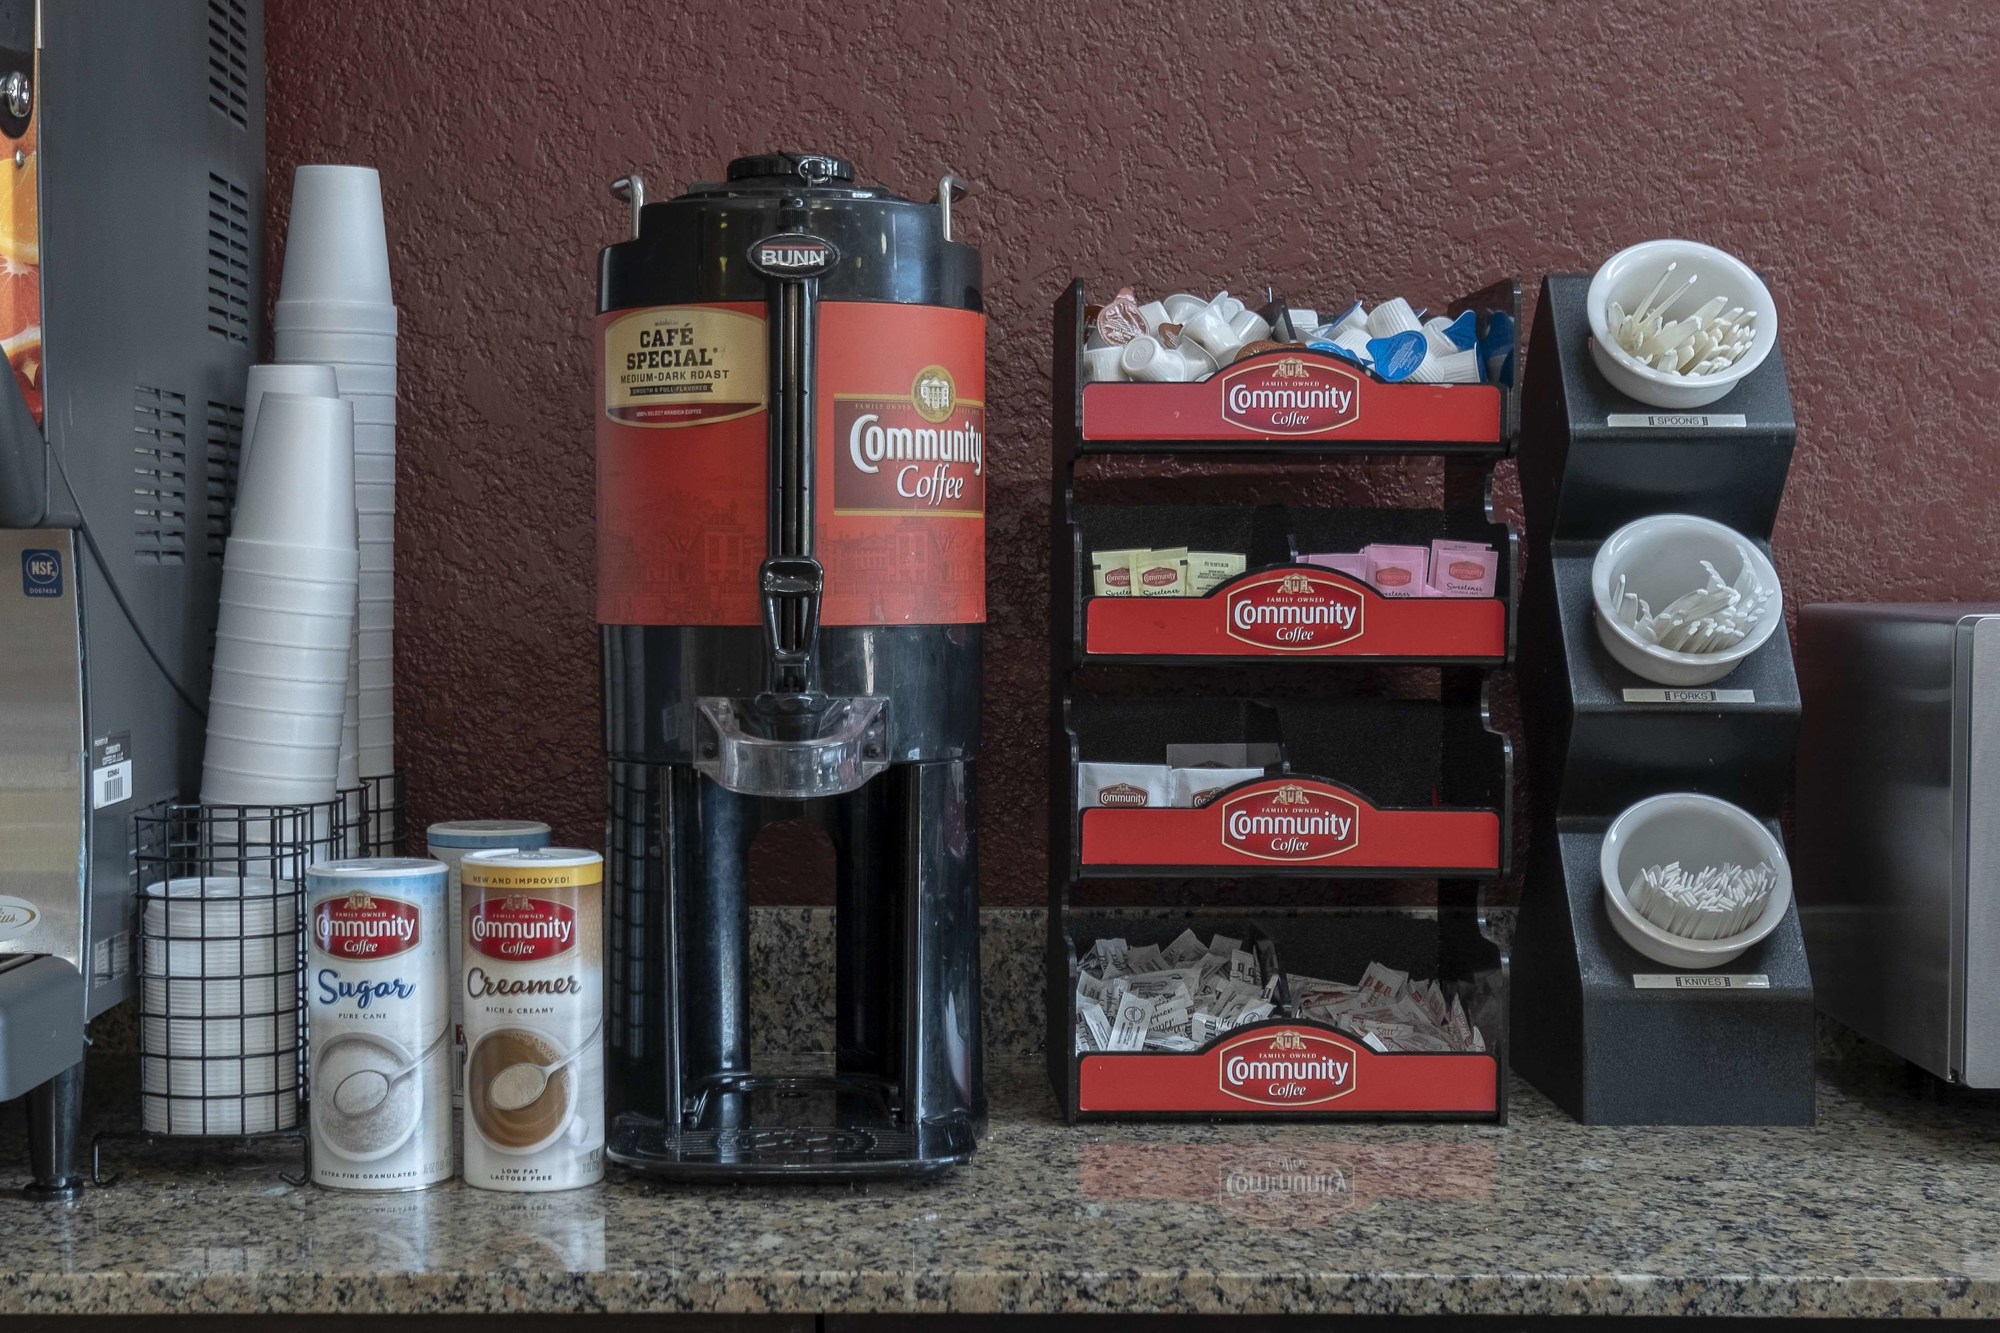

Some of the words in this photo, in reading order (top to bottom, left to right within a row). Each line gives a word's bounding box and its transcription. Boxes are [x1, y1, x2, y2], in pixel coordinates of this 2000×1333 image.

[762, 250, 824, 266] BUNN
[640, 322, 694, 348] CAFÉ
[621, 371, 686, 384] MEDIUM-DARK
[691, 370, 730, 380] ROAST
[1229, 384, 1352, 414] Community
[1271, 411, 1310, 427] Coffee
[1657, 416, 1700, 425] SPOONS
[850, 413, 982, 476] Community
[896, 463, 964, 507] Coffee
[31, 561, 54, 575] NSF
[1234, 600, 1357, 630] Community
[1276, 627, 1314, 643] Coffee
[1673, 692, 1708, 700] FORKS
[1101, 792, 1147, 805] Community
[1229, 810, 1351, 841] Community
[1271, 837, 1309, 853] Coffee
[473, 875, 489, 883] NEW
[492, 877, 511, 885] AND
[515, 876, 570, 885] IMPROVED!
[316, 914, 415, 941] Community
[472, 915, 572, 942] Community
[344, 939, 378, 955] Coffee
[501, 941, 535, 956] Coffee
[318, 968, 416, 1009] Sugar
[467, 966, 583, 1000] Creamer
[1684, 978, 1722, 986] KNIVES
[338, 1012, 358, 1020] PURE
[363, 1012, 388, 1020] CANE
[485, 1006, 505, 1014] RICH
[517, 1006, 555, 1015] CREAMY
[1227, 1056, 1349, 1086] Community
[1268, 1082, 1307, 1098] Coffee
[321, 1169, 340, 1178] EXTRA
[342, 1171, 359, 1179] FINE
[363, 1171, 417, 1180] GRANULATED
